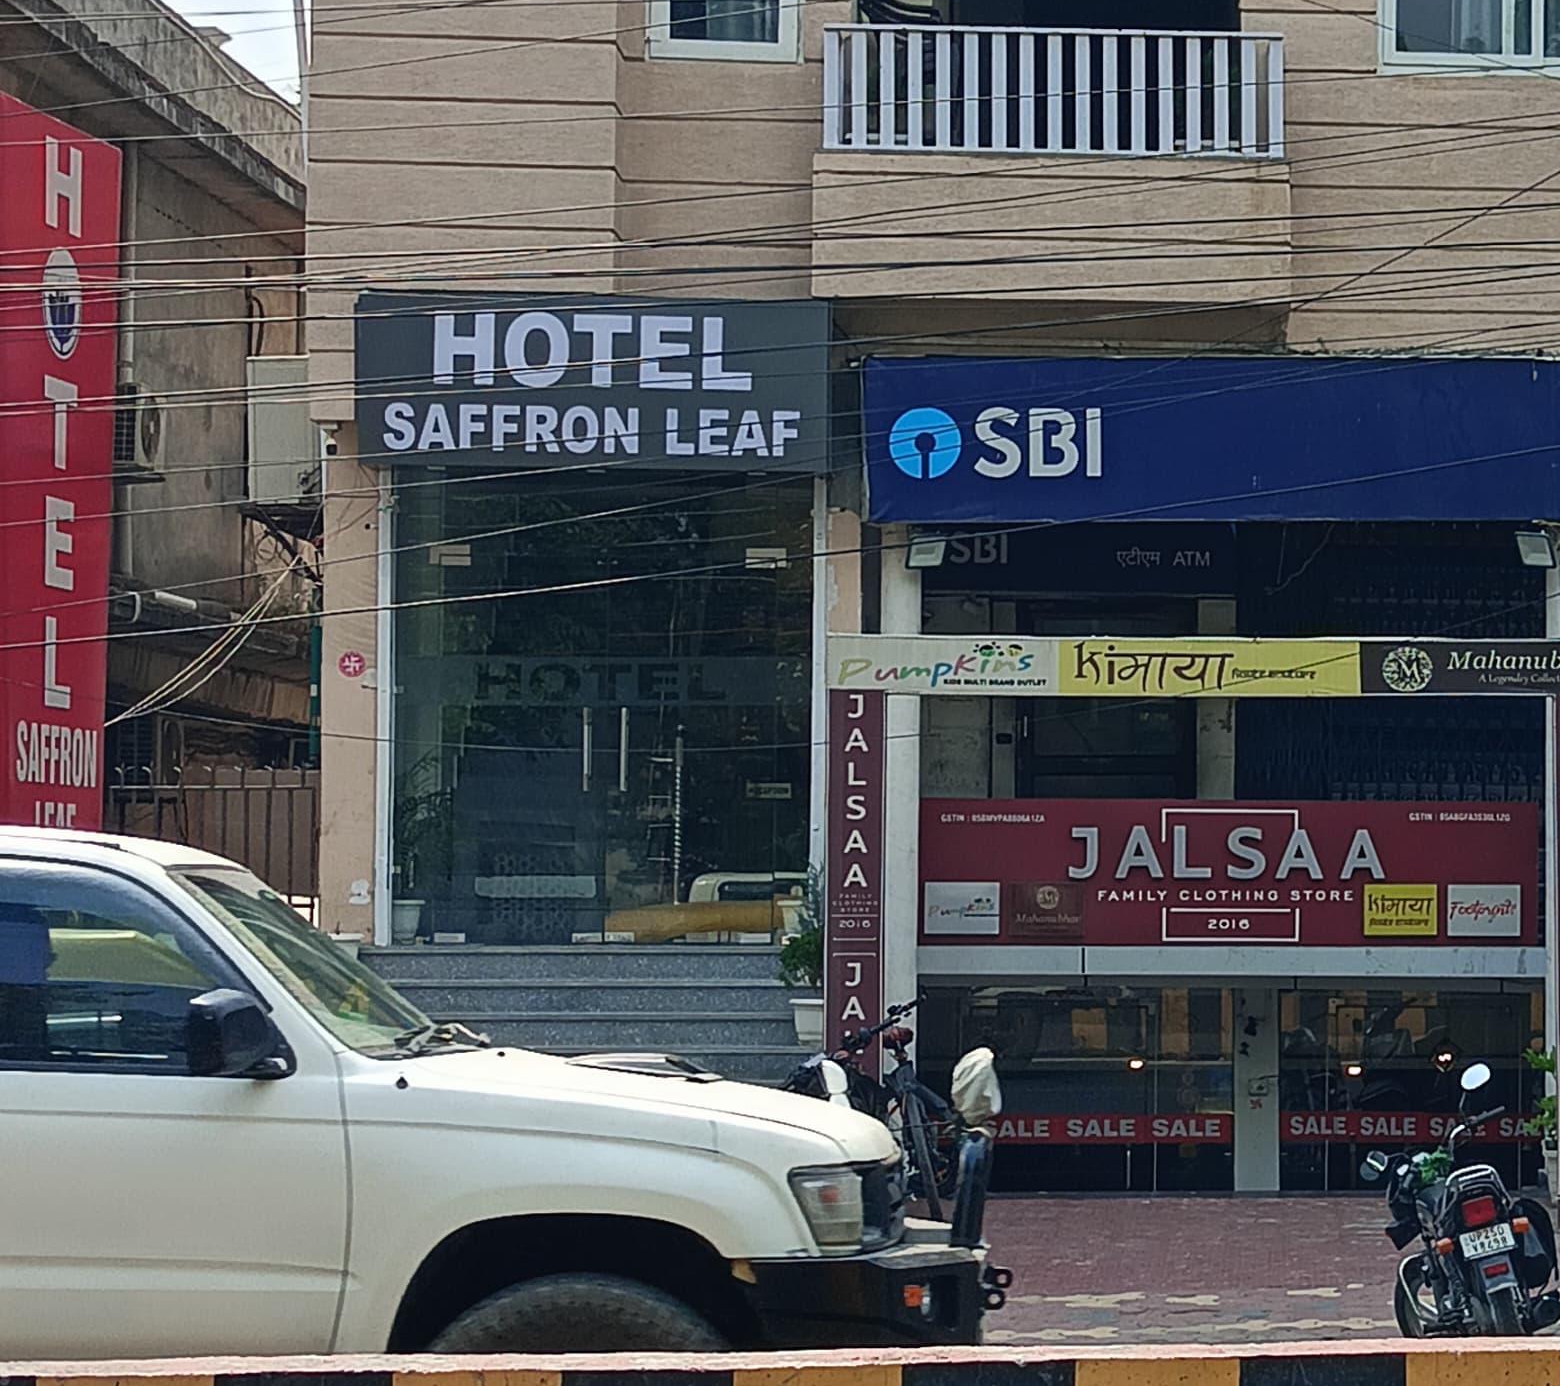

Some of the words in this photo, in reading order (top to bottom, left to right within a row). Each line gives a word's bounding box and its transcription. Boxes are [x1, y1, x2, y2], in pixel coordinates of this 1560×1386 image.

[433, 312, 753, 392] HOTEL
[383, 401, 640, 455] SAFFRON
[665, 407, 801, 457] LEAF
[973, 406, 1103, 478] SBI
[950, 532, 1008, 564] SBI
[1116, 546, 1160, 567] एटीएम
[1173, 551, 1210, 566] ATM
[474, 663, 728, 701] HOTEL
[16, 720, 98, 788] SAFFRON
[843, 694, 869, 888] JALSAA
[1068, 824, 1387, 880] JALSAA
[1097, 890, 1168, 902] FAMILY
[1178, 890, 1280, 902] CLOTHING
[1290, 890, 1354, 902] STORE
[839, 919, 871, 929] 2016
[1207, 918, 1250, 930] 2016
[982, 1118, 1050, 1138] SALE
[1067, 1118, 1136, 1138] SALE
[1152, 1118, 1221, 1138] SALE
[1290, 1116, 1346, 1136] SALE
[1360, 1116, 1416, 1137] SALE
